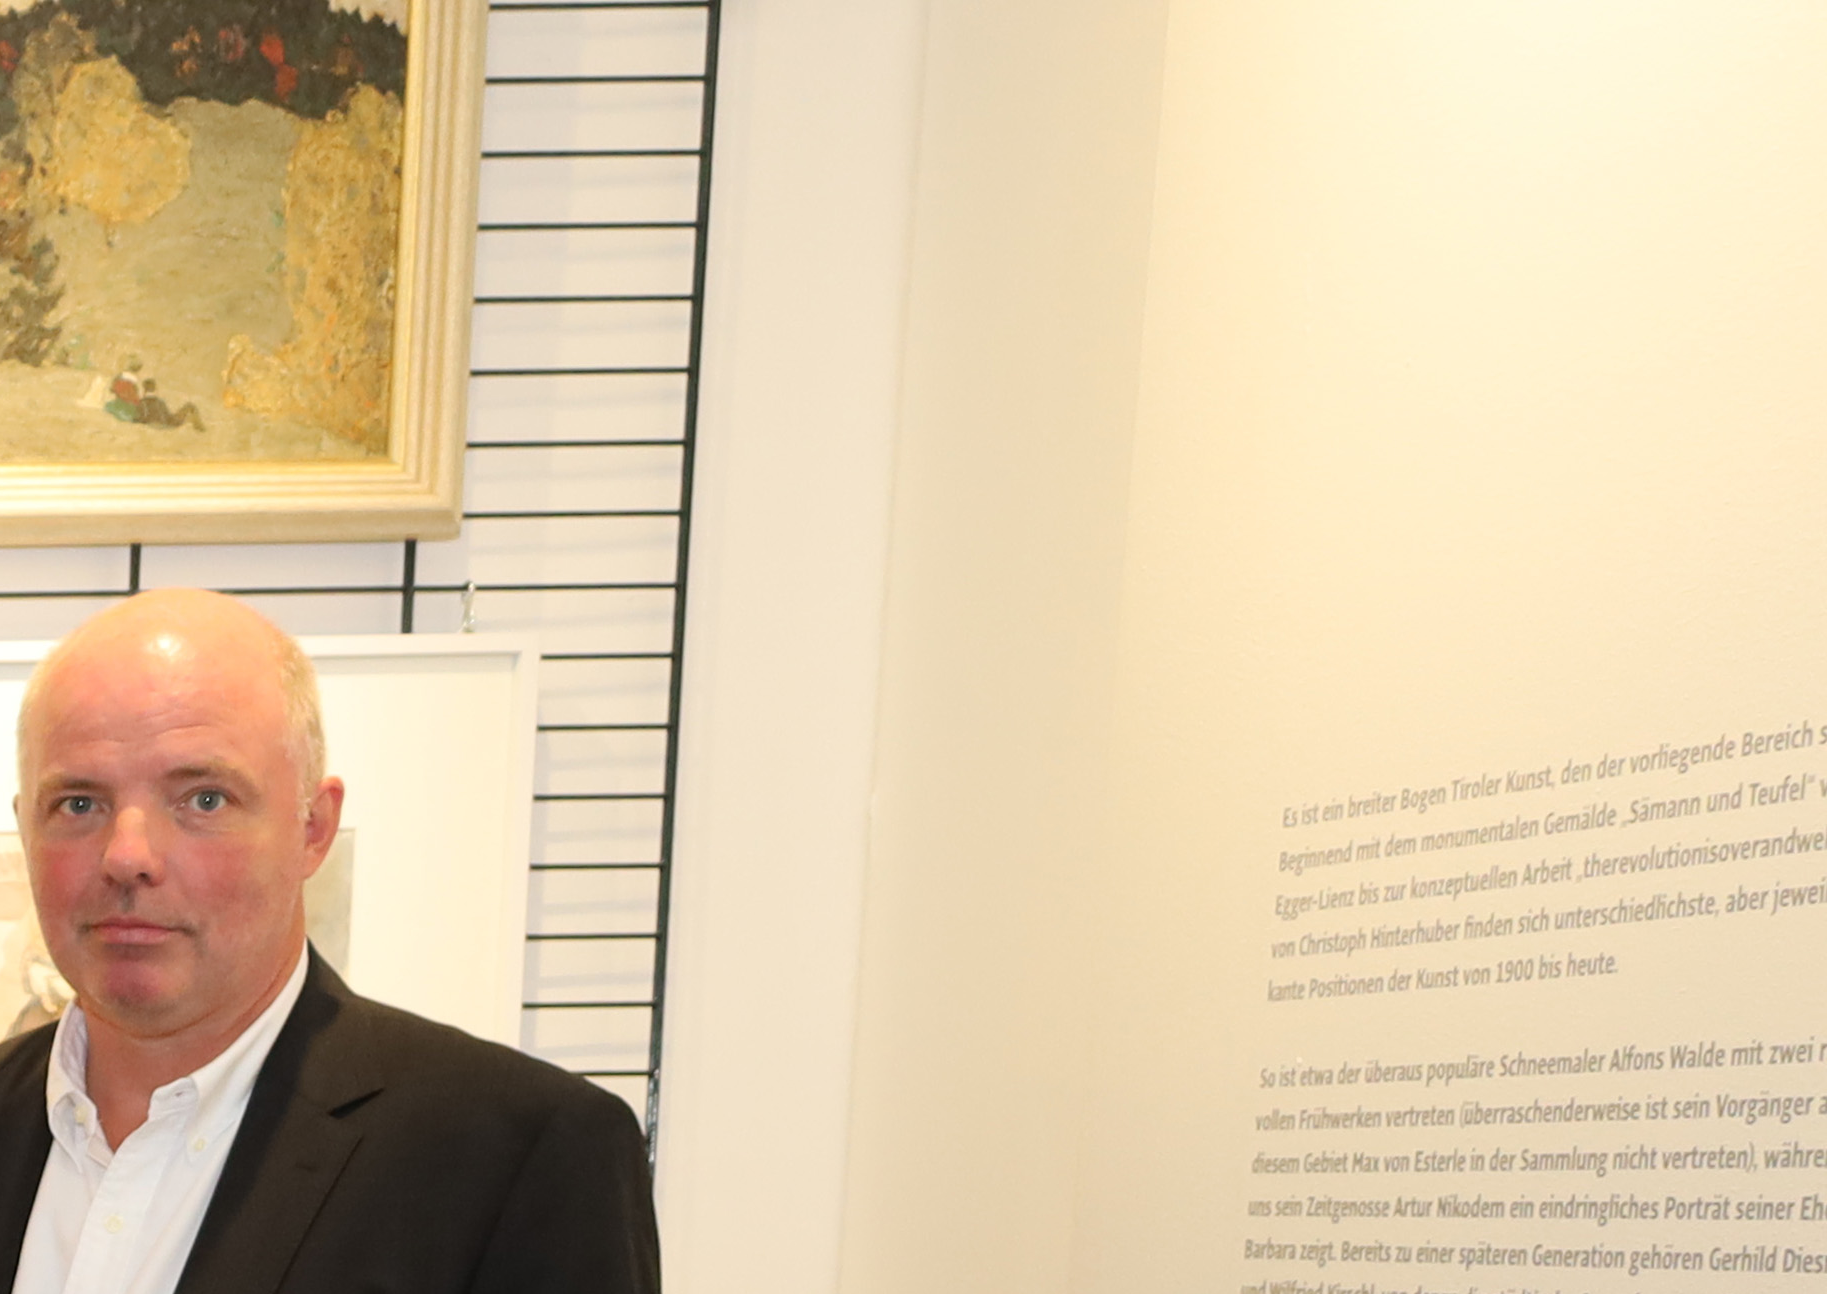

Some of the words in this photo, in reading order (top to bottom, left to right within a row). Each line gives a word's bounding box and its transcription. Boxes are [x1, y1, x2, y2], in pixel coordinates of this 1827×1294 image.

[1347, 791, 1398, 819] breiter
[1399, 786, 1447, 815] Bogen
[1450, 773, 1503, 803] Tiroler
[1560, 758, 1593, 786] den
[1596, 753, 1627, 781] der
[1629, 733, 1737, 776] vorliegende
[1740, 719, 1814, 758] Bereich
[1278, 839, 1354, 878] Beginnend
[1355, 836, 1381, 863] mit
[1383, 833, 1417, 858] dem
[1420, 814, 1540, 853] monumentalen
[1543, 801, 1618, 836] Gemälde
[1705, 782, 1744, 814] und
[1274, 887, 1356, 922] Egger-Lienz
[1358, 882, 1380, 907] bis
[1382, 884, 1408, 904] zur
[1409, 865, 1519, 903] konzeptuellen
[1520, 856, 1574, 887] Arbeit
[1298, 927, 1367, 959] Christoph
[1369, 918, 1461, 949] Hinterhuber
[1463, 912, 1514, 940] finden
[1516, 906, 1551, 935] sich
[1724, 884, 1770, 914] aber
[1308, 973, 1385, 1000] Positionen
[1386, 968, 1413, 993] der
[1415, 965, 1460, 990] Kunst
[1462, 967, 1492, 987] von
[1494, 958, 1535, 985] 1900
[1537, 953, 1563, 981] bis
[1336, 1061, 1362, 1086] der
[1364, 1060, 1423, 1085] überaus
[1425, 1054, 1496, 1089] populäre
[1498, 1048, 1607, 1078] Schneemaler
[1608, 1044, 1665, 1073] Alfons
[1669, 1040, 1726, 1070] Walde
[1730, 1039, 1764, 1067] mit
[1767, 1036, 1815, 1066] zwei
[1298, 1105, 1382, 1131] Frühwerken
[1385, 1105, 1456, 1128] vertreten
[1644, 1094, 1669, 1121] ist
[1671, 1092, 1711, 1121] sein
[1715, 1090, 1815, 1127] Vorgänger
[1303, 1150, 1349, 1174] Gebiet
[1351, 1151, 1380, 1174] Max
[1383, 1155, 1411, 1174] von
[1413, 1148, 1467, 1173] Esterle
[1469, 1147, 1486, 1172] in
[1488, 1147, 1517, 1173] der
[1519, 1145, 1609, 1179] Sammlung
[1612, 1144, 1658, 1171] nicht
[1305, 1195, 1391, 1225] Zeitgenosse
[1392, 1196, 1434, 1219] Artur
[1436, 1193, 1506, 1219] Nikodem
[1509, 1194, 1535, 1220] ein
[1538, 1193, 1660, 1228] eindringliches
[1663, 1194, 1731, 1221] Porträt
[1734, 1194, 1796, 1222] seiner
[1340, 1240, 1392, 1264] Bereits
[1394, 1246, 1413, 1264] zu
[1415, 1240, 1456, 1265] einer
[1457, 1241, 1529, 1273] späteren
[1531, 1243, 1626, 1269] Generation
[1627, 1243, 1704, 1278] gehören
[1708, 1245, 1779, 1274] Gerhild
